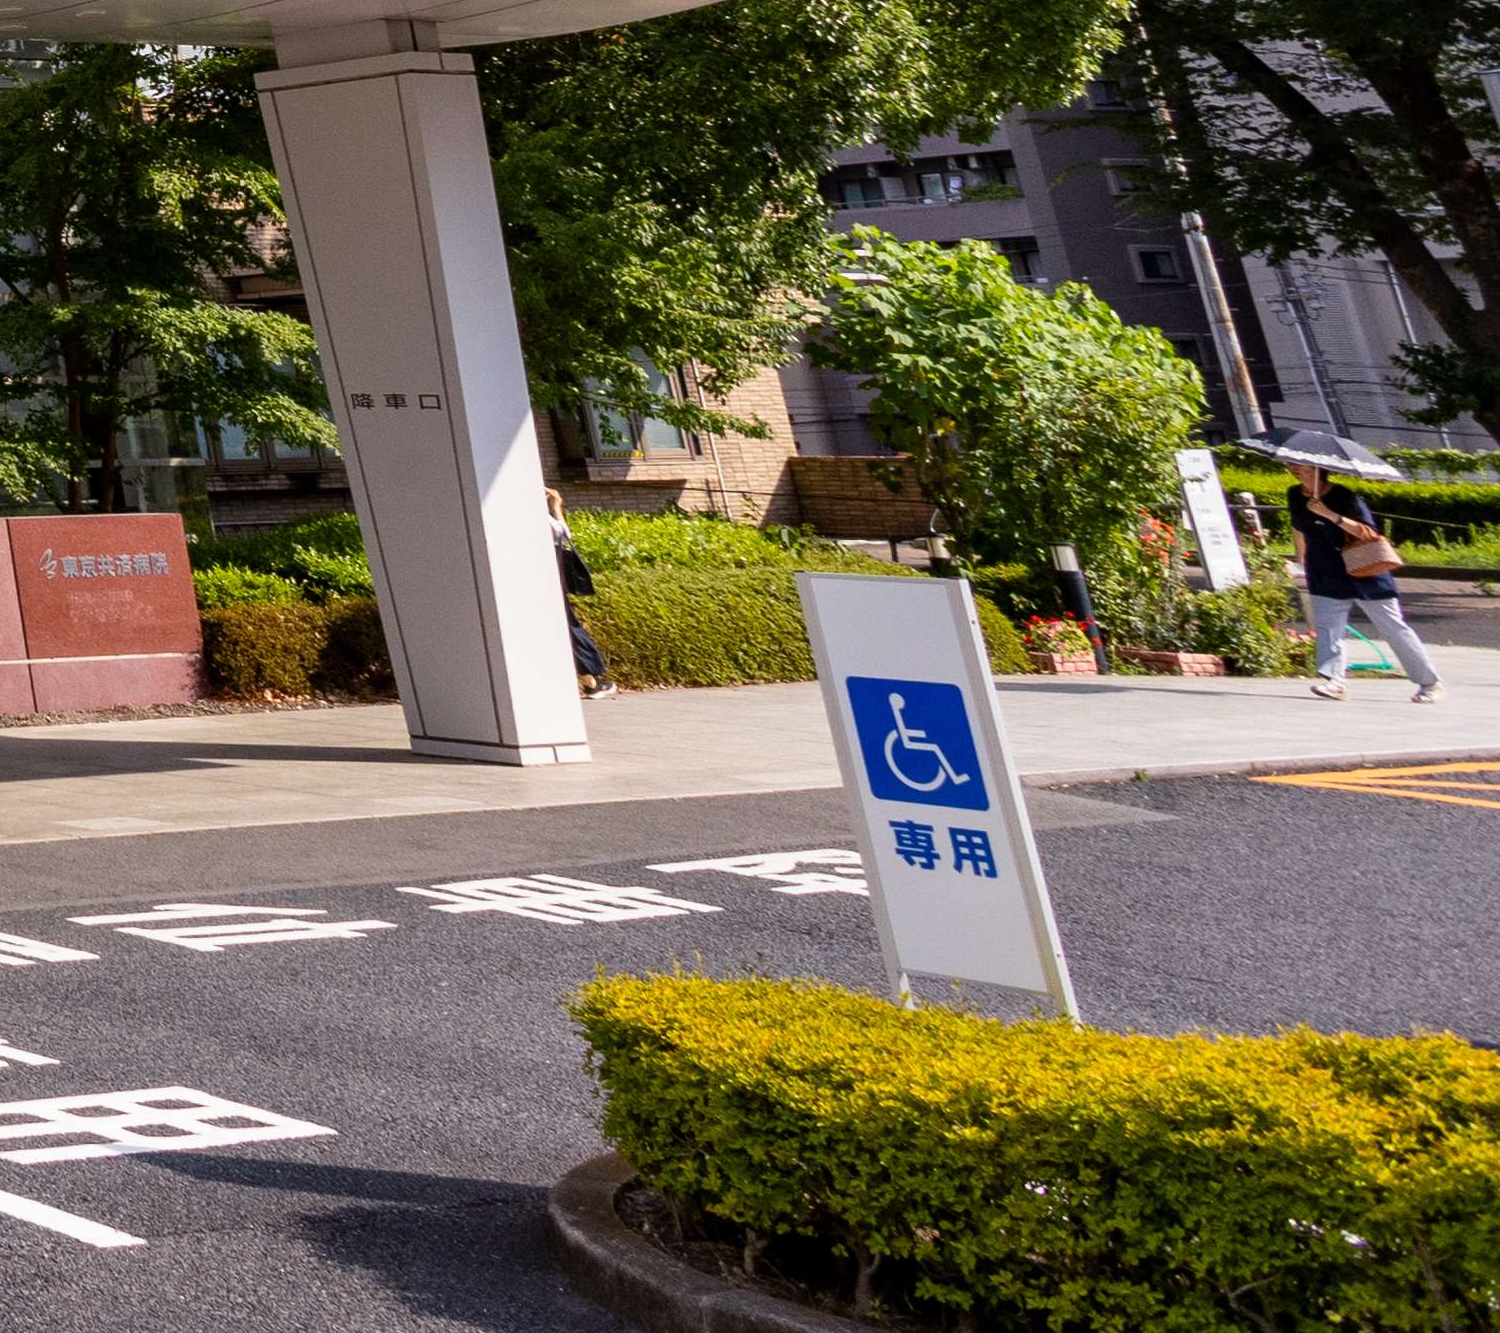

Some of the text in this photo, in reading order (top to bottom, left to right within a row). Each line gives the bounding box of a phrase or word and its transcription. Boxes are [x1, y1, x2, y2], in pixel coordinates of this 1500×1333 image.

[350, 393, 442, 410] 降車口
[60, 552, 170, 579] 東京共済病院
[888, 820, 999, 879] 専用
